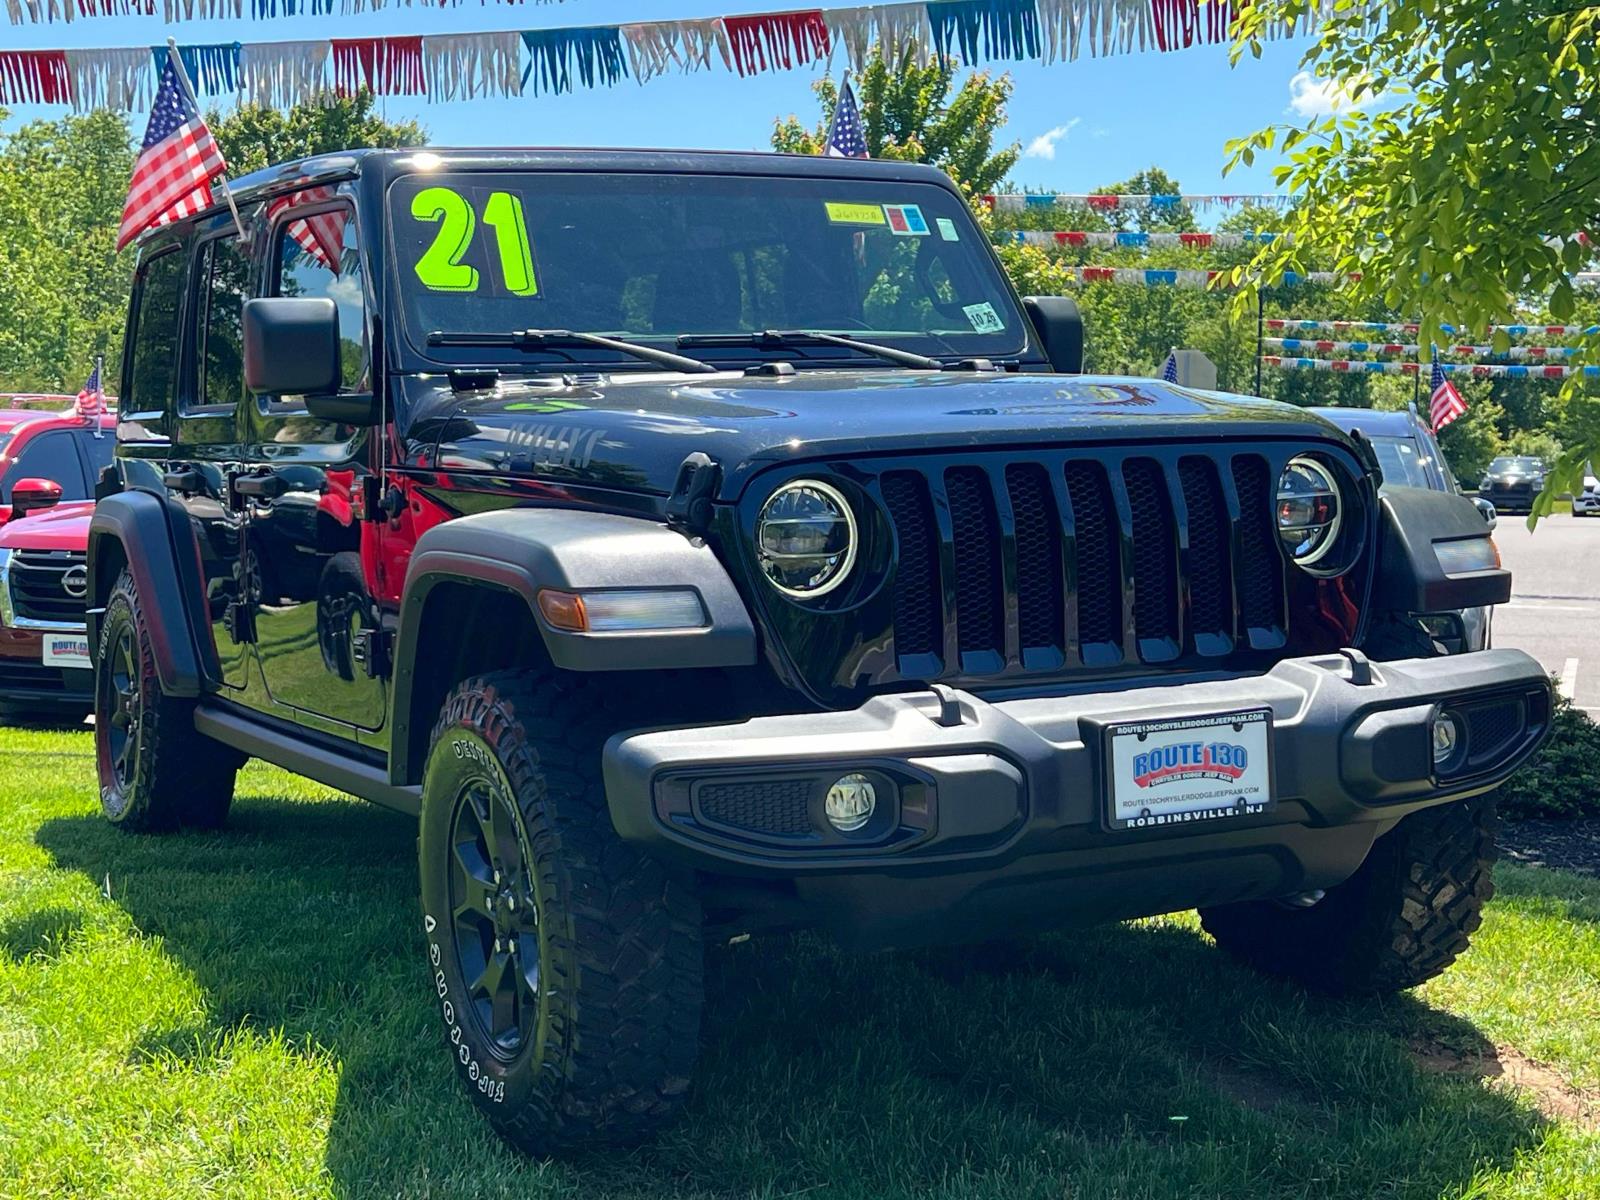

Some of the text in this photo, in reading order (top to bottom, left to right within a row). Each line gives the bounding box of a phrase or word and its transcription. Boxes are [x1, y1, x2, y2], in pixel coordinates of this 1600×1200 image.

[411, 187, 538, 296] 21
[52, 641, 77, 650] ROUTE
[1134, 742, 1247, 778] ROUTE 130
[1182, 771, 1203, 780] DODGE
[1204, 771, 1218, 779] JEEP
[1218, 772, 1233, 782] RAM
[1127, 804, 1264, 828] ROBBINSVILLE, NJ
